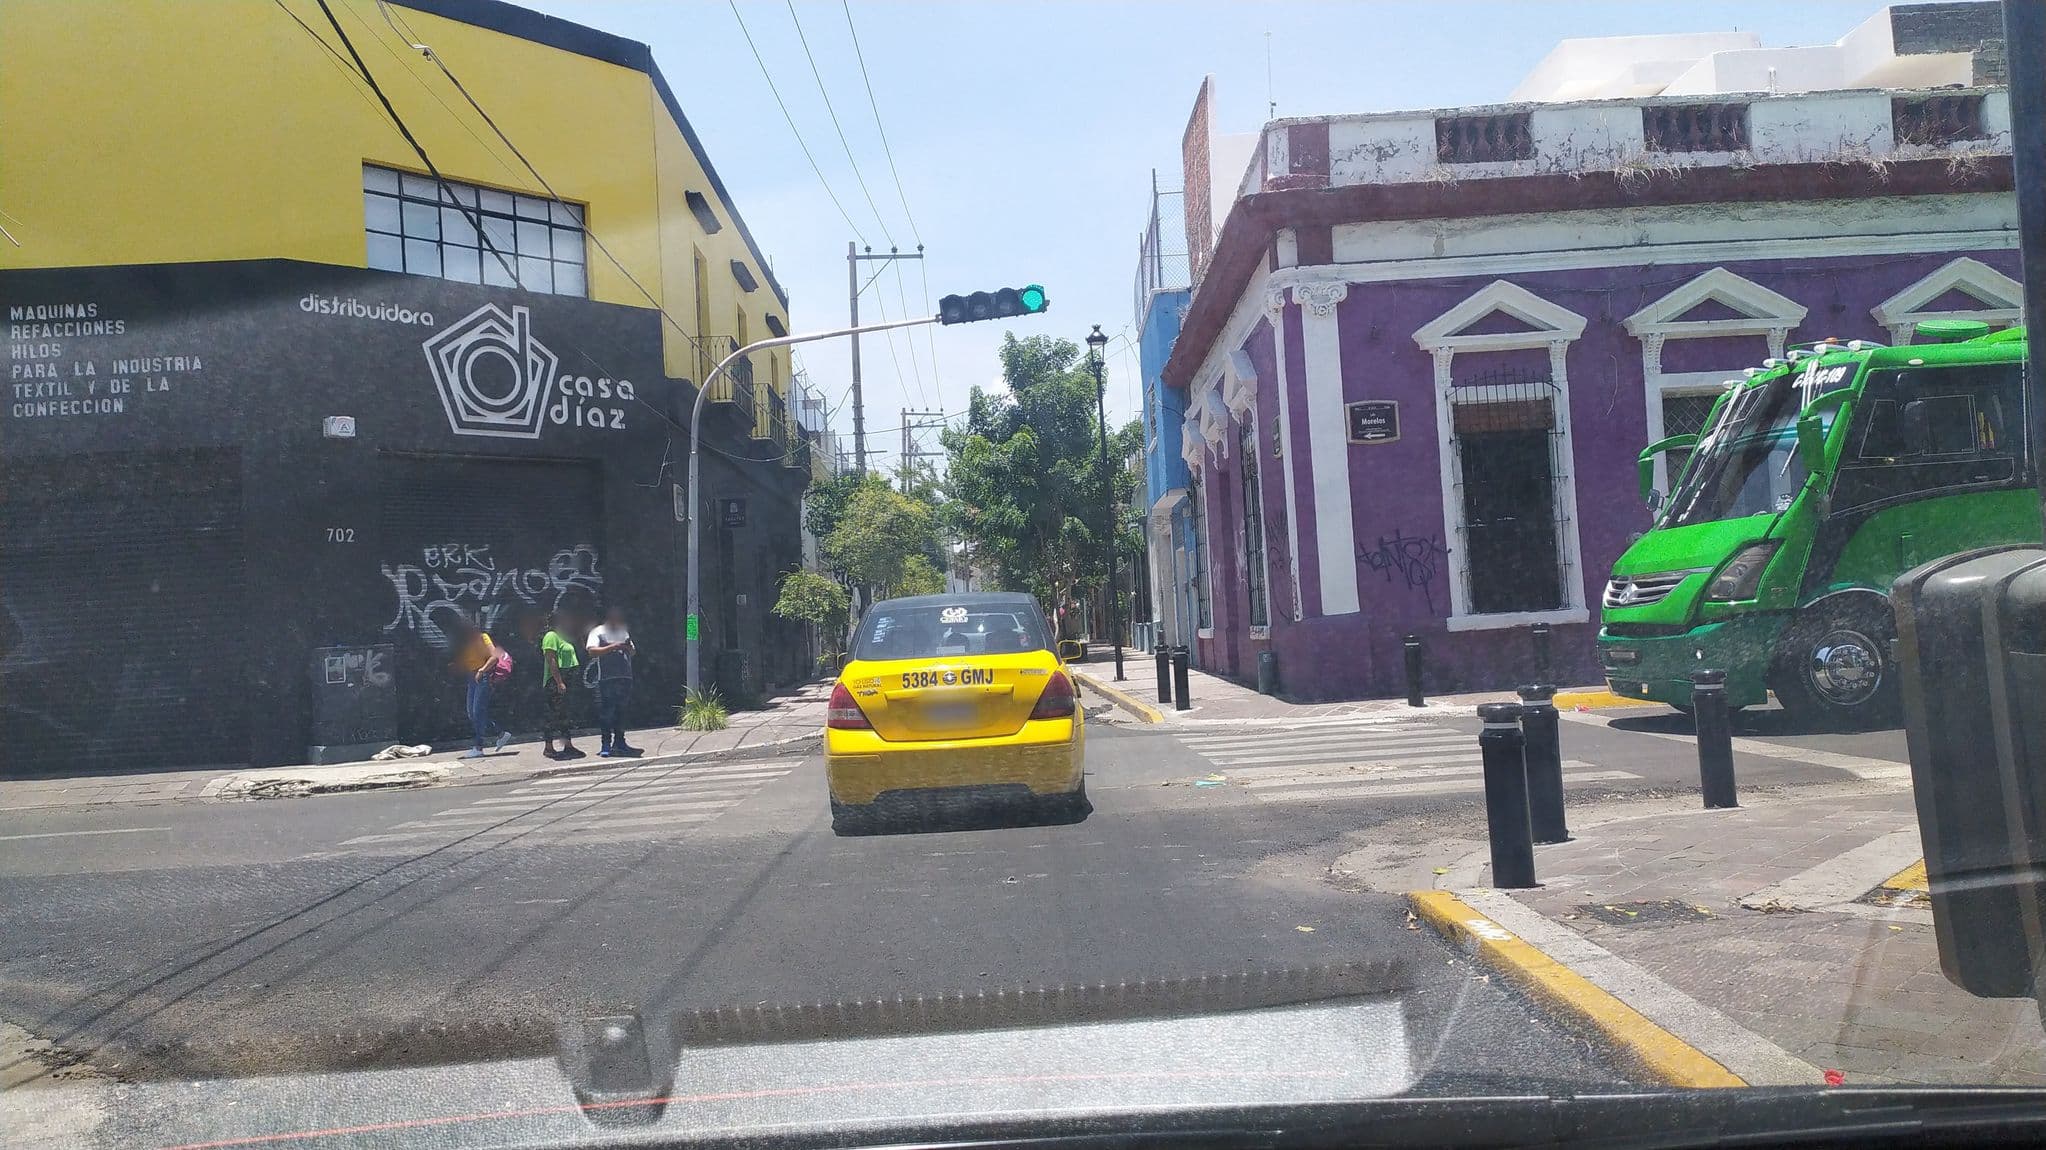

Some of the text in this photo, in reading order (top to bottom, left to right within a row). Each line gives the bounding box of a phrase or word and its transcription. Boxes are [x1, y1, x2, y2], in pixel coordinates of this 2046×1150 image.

[10, 303, 98, 321] MAQUINAS
[300, 294, 434, 326] distribuidora
[11, 320, 125, 340] REFACCIONES
[11, 343, 61, 360] HILOS
[12, 355, 202, 379] PARA LA INDUSTRIA
[13, 377, 170, 399] TEXTIL Y DE LA
[558, 374, 636, 400] casa
[12, 398, 124, 418] CONFECCION
[1361, 417, 1386, 425] Morelos
[326, 528, 355, 543] 702
[902, 668, 994, 689] 5384 GMJ
